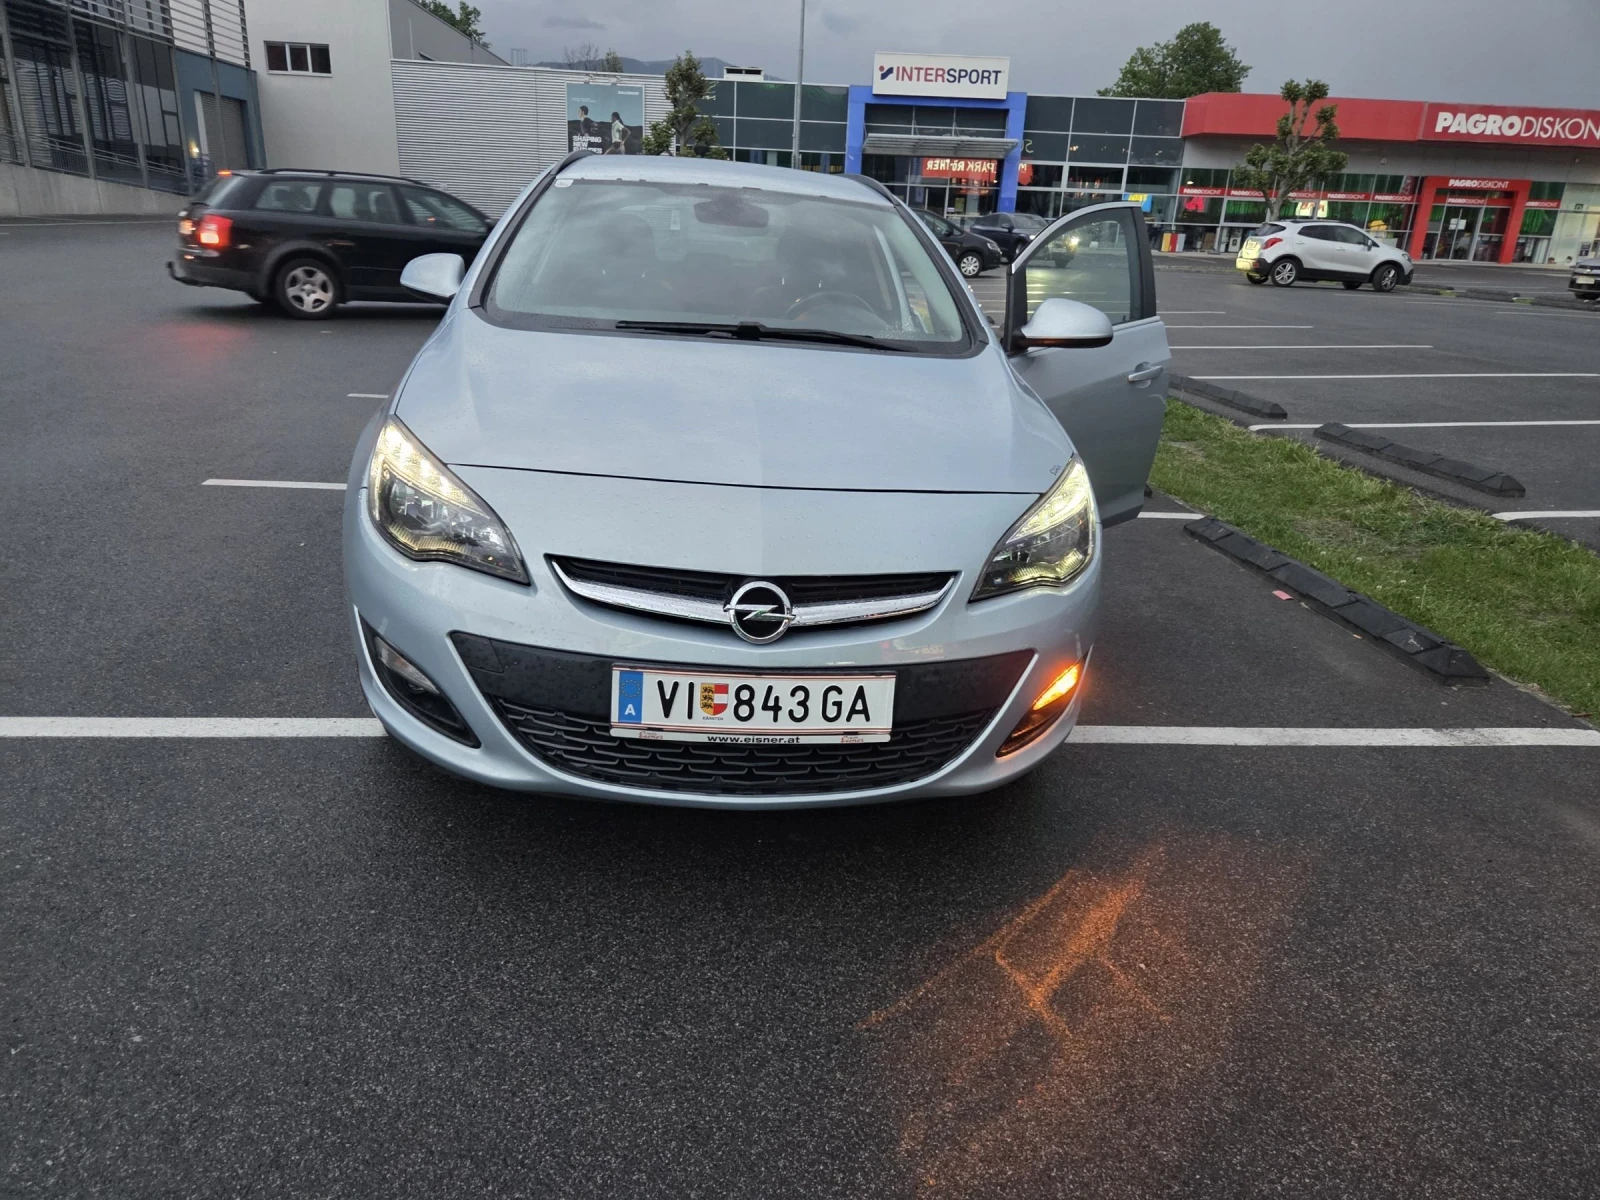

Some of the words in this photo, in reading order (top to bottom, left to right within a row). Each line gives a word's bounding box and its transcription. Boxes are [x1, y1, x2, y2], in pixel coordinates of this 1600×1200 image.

[896, 66, 1002, 85] INTERSPORT
[1435, 112, 1600, 140] PAGRODISKON
[624, 704, 636, 716] A
[657, 680, 694, 720] VI
[733, 684, 810, 723] 843
[821, 685, 871, 723] GA
[707, 735, 800, 744] www.eisner.at
